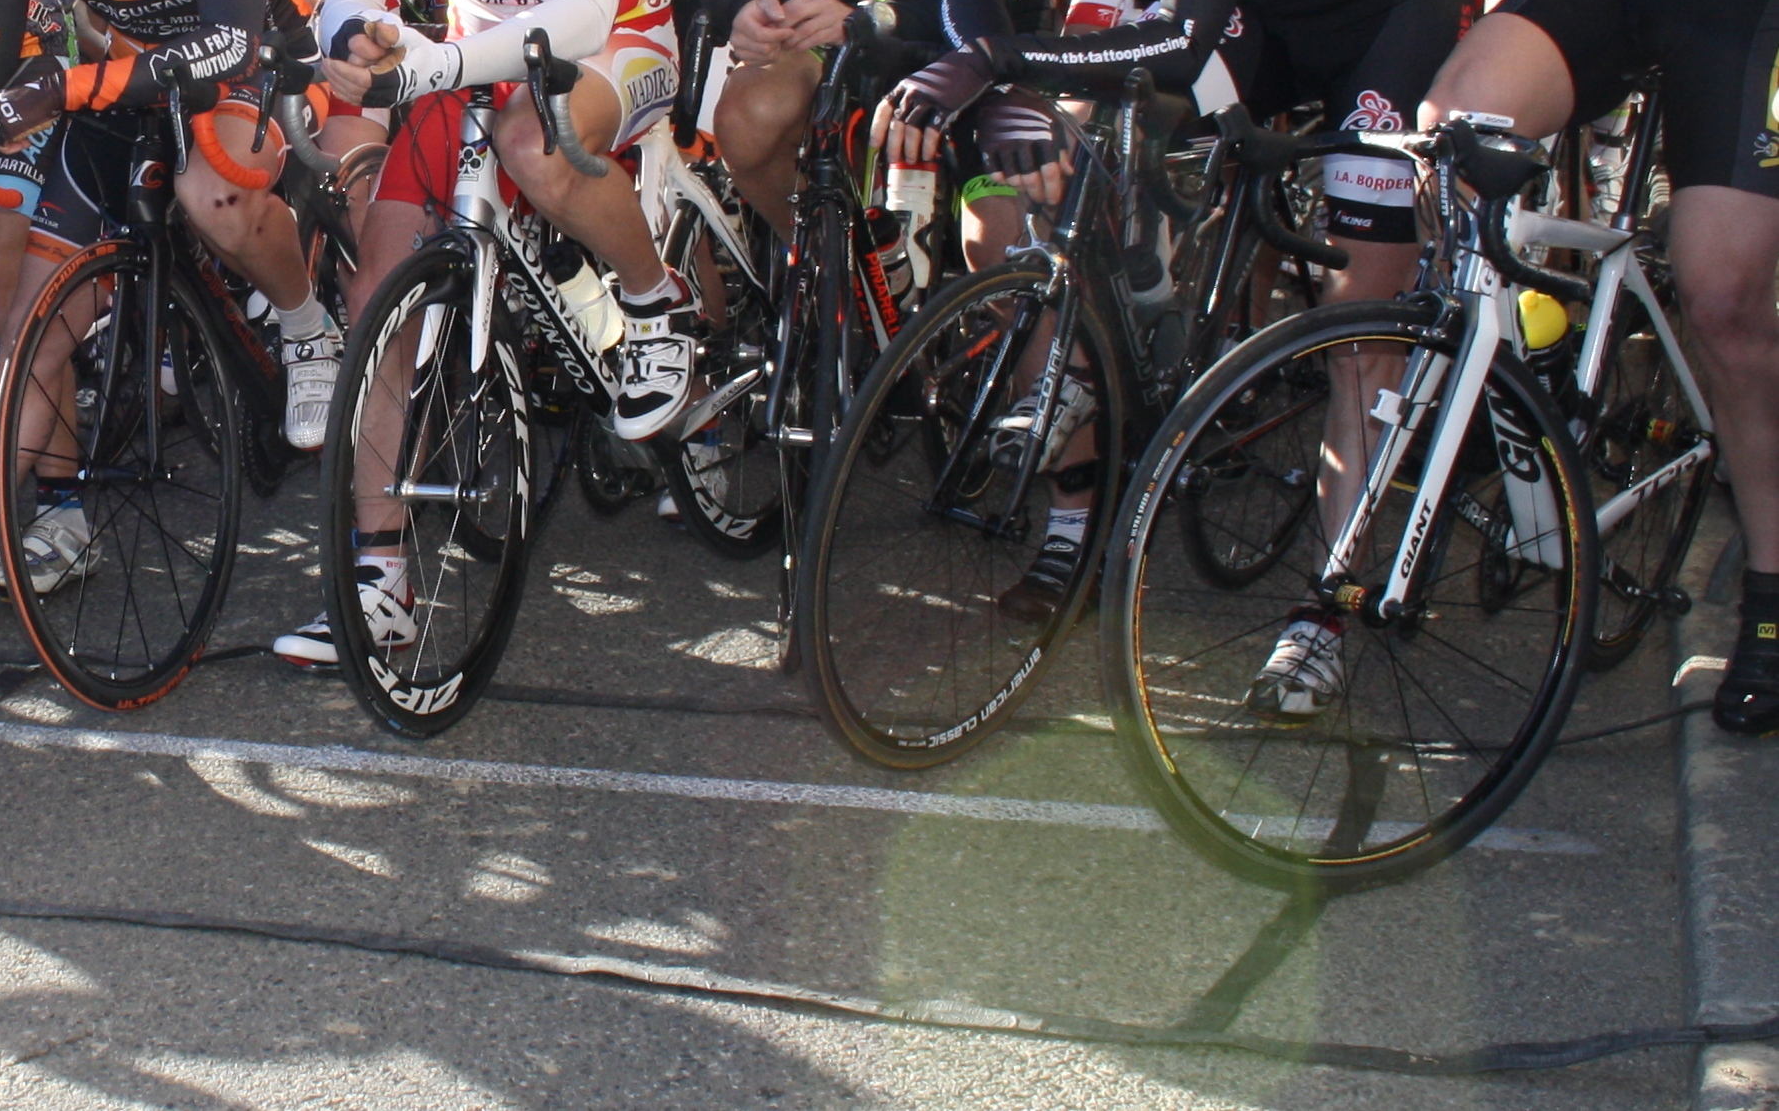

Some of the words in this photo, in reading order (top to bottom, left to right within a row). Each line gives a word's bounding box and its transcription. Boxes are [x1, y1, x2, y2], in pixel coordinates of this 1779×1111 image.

[183, 42, 203, 61] LA
[507, 272, 594, 394] COLNAGO
[865, 251, 903, 340] PINARELL
[1029, 336, 1062, 440] SCOTT
[1399, 498, 1432, 580] GIANT
